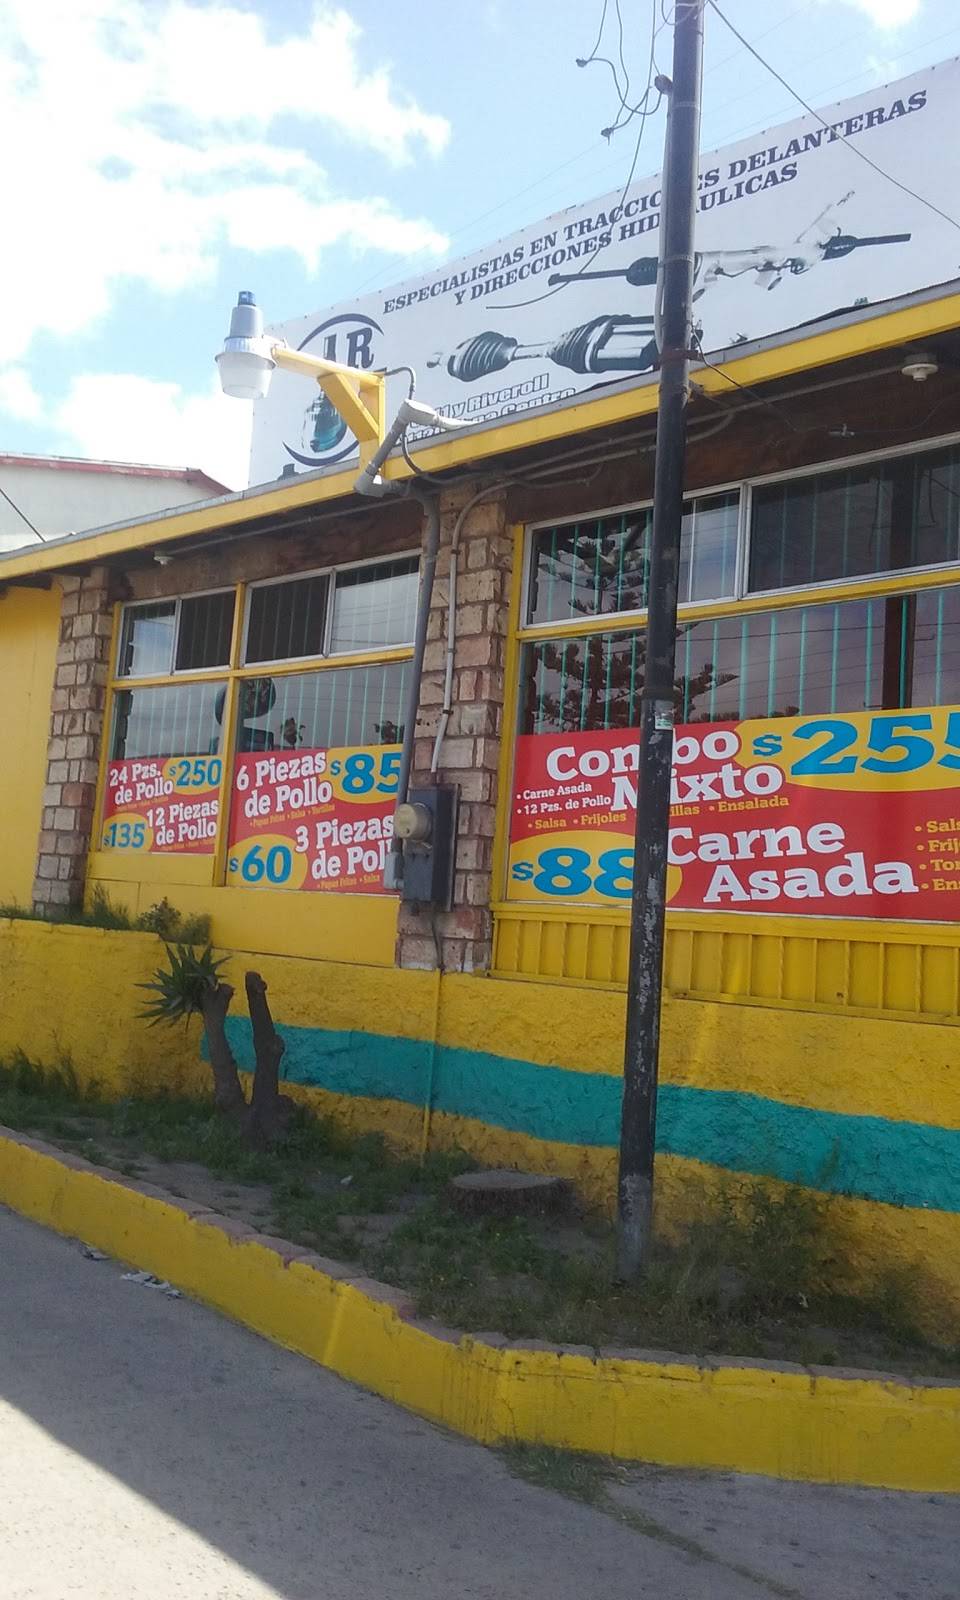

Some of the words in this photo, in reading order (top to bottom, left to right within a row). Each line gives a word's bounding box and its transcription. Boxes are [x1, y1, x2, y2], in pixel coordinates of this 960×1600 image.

[383, 246, 525, 314] ESPECIALISTAS
[530, 231, 557, 257] EN
[563, 169, 720, 242] TRACCIOS
[727, 90, 928, 181] DELANTERAS
[454, 290, 466, 306] Y
[470, 230, 612, 301] DIRECCIONES
[618, 161, 799, 242] HIDULICAS
[466, 372, 549, 413] Riveroll
[109, 766, 128, 787] 24
[132, 763, 161, 782] Pzs.
[168, 759, 222, 787] $250
[236, 765, 249, 791] 6
[255, 752, 326, 787] Piezas
[114, 786, 133, 805] de
[135, 777, 174, 801] Pollo
[244, 790, 271, 818] de
[275, 777, 333, 812] Pollo
[523, 789, 555, 800] Carne
[556, 782, 592, 796] Asada
[524, 804, 538, 815] 12
[540, 802, 563, 813] Pzs.
[565, 799, 580, 810] de
[582, 794, 611, 807] Pollo
[718, 795, 790, 813] Ensalada
[146, 807, 165, 828] 12
[169, 800, 219, 823] Piezas
[534, 817, 567, 829] Salsa
[580, 811, 627, 826] Frijoles
[156, 826, 175, 846] de
[178, 818, 217, 842] Pollo
[295, 826, 309, 852] 3
[316, 815, 394, 849] Piezas
[667, 821, 846, 865] Carne
[312, 850, 341, 879] de
[703, 851, 920, 903] Asada
